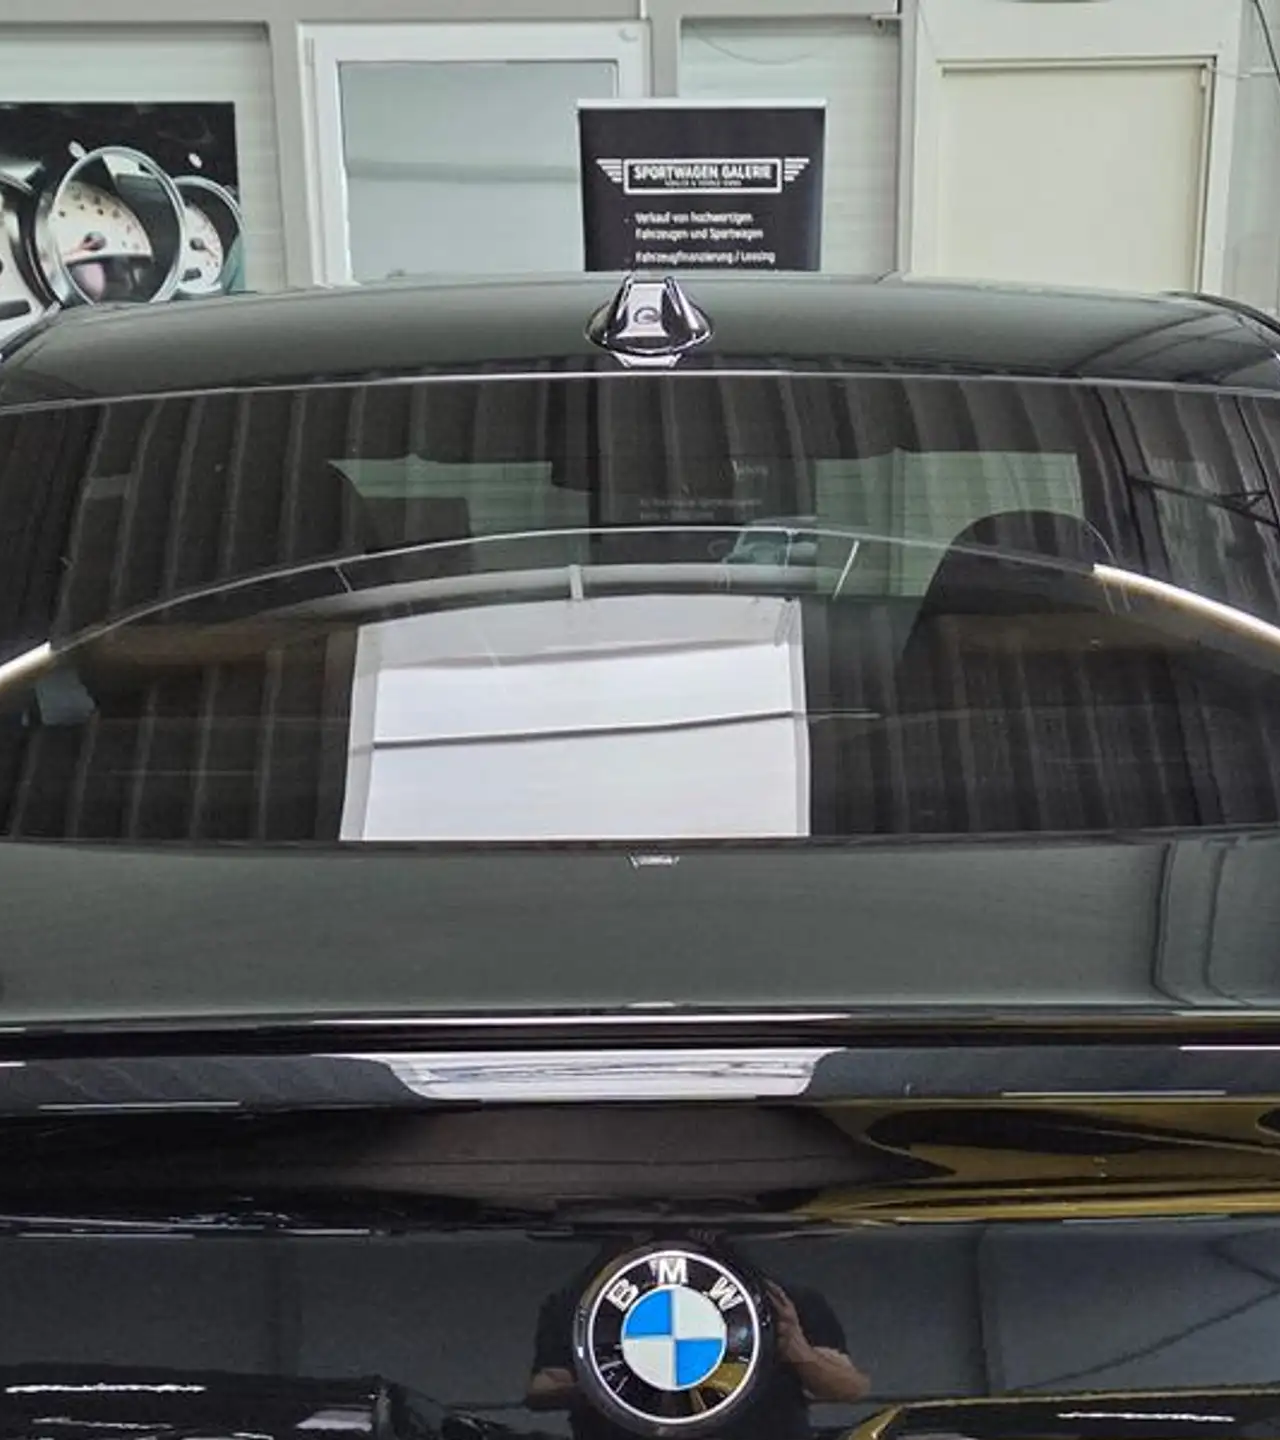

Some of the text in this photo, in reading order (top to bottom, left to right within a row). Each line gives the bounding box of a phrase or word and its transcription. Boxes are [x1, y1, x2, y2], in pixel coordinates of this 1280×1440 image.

[634, 165, 773, 179] SPORTWAGEN GALERIE
[606, 1257, 744, 1312] BMW
